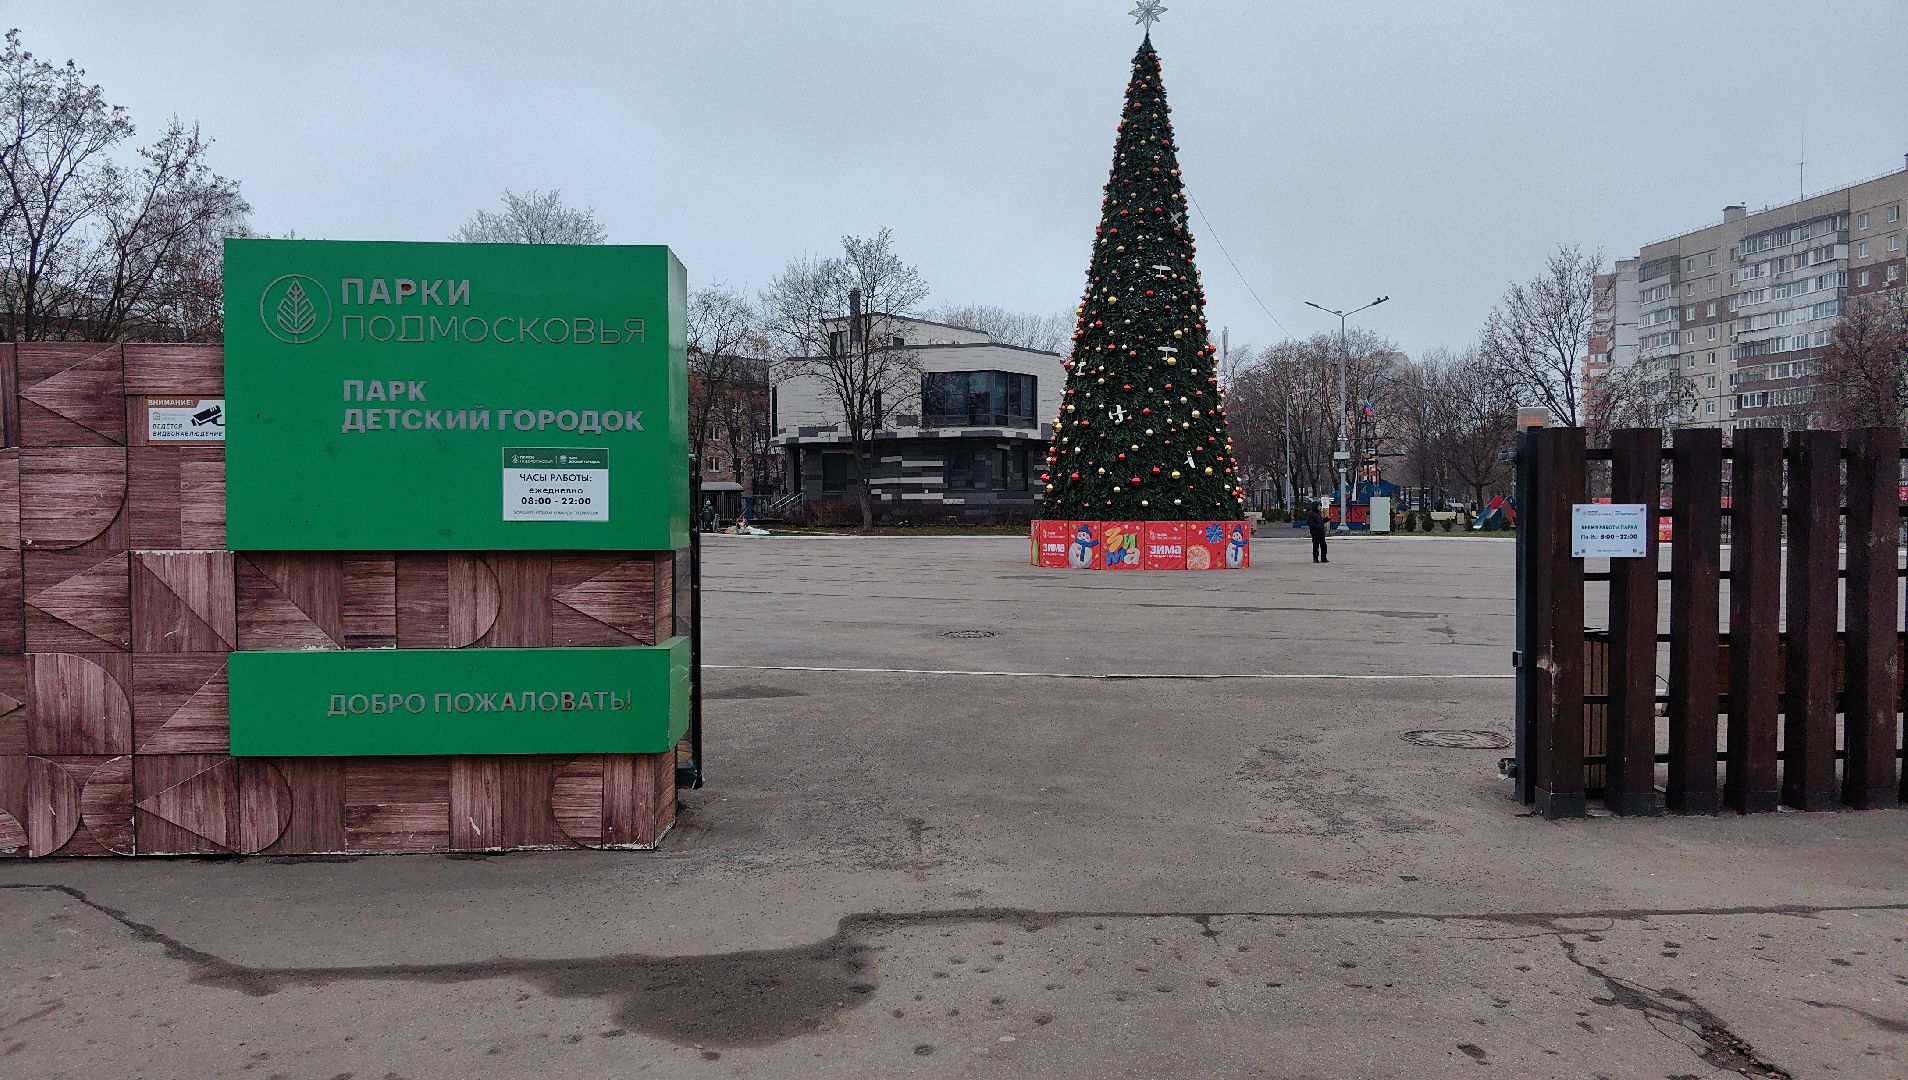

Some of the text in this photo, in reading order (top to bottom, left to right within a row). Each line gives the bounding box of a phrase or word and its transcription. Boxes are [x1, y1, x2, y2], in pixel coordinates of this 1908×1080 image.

[341, 278, 470, 306] ПАРКИ
[342, 315, 646, 344] ПОДМОСКОВЬЯ
[343, 379, 427, 402] ПАРК
[341, 404, 646, 435] ДЕТСКИЙ ГОРОДОК
[519, 474, 593, 482] ЧАСЫ РАБОТЫ:
[521, 497, 552, 505] 08:00
[561, 497, 592, 505] 22:00
[327, 689, 633, 718] ДОБРО ПОЖАЛОВАТЬ!
